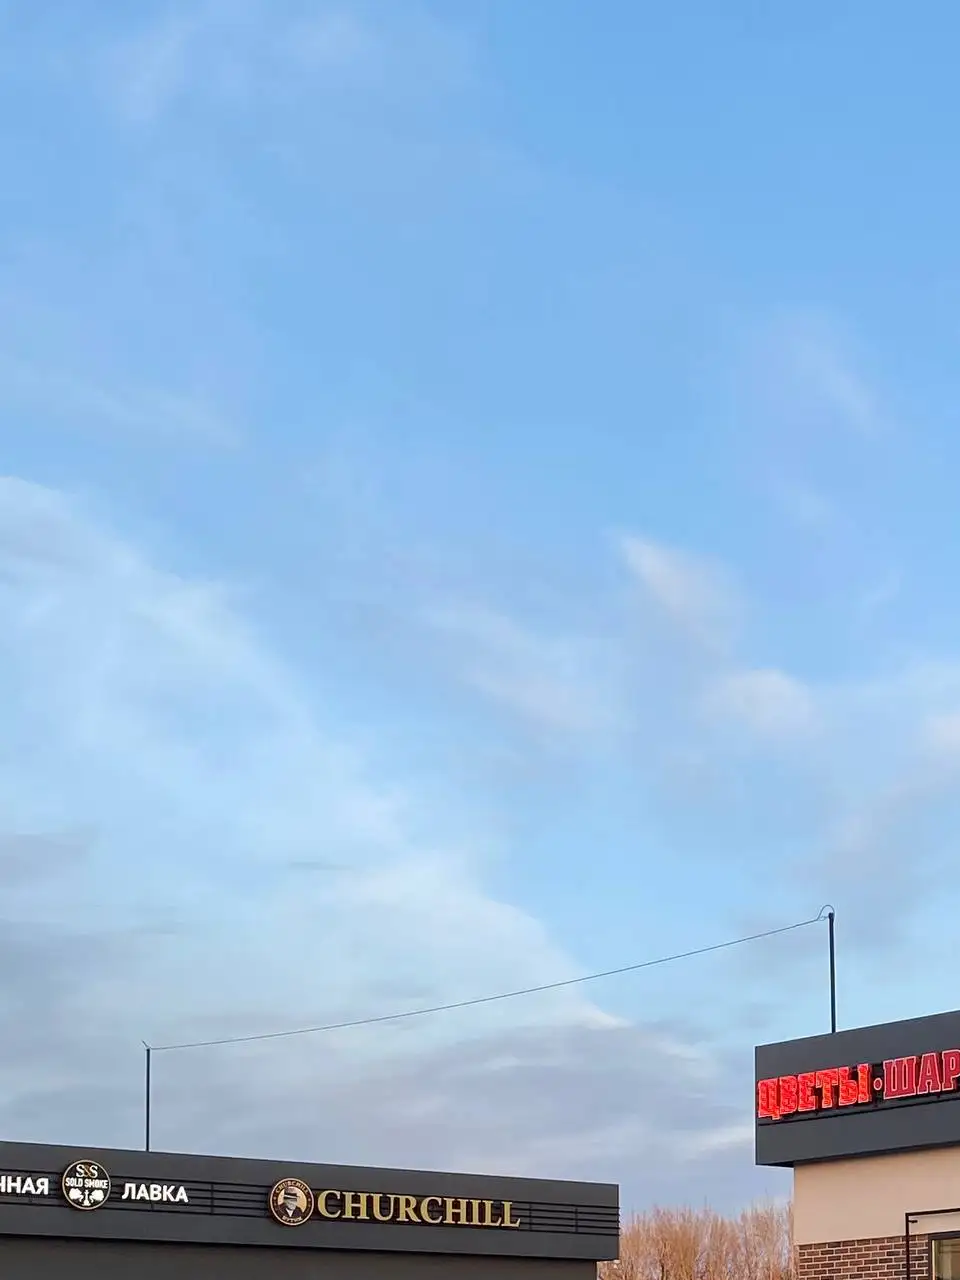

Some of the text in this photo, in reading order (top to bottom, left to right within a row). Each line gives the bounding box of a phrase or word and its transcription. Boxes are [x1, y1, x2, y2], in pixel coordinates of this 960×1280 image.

[757, 1062, 870, 1120] ЦВЕТЫ
[75, 1164, 99, 1178] S&S
[65, 1177, 109, 1190] SOLD SMOKE
[121, 1183, 189, 1203] ЛАВКА
[317, 1190, 521, 1228] CHURCHILL
